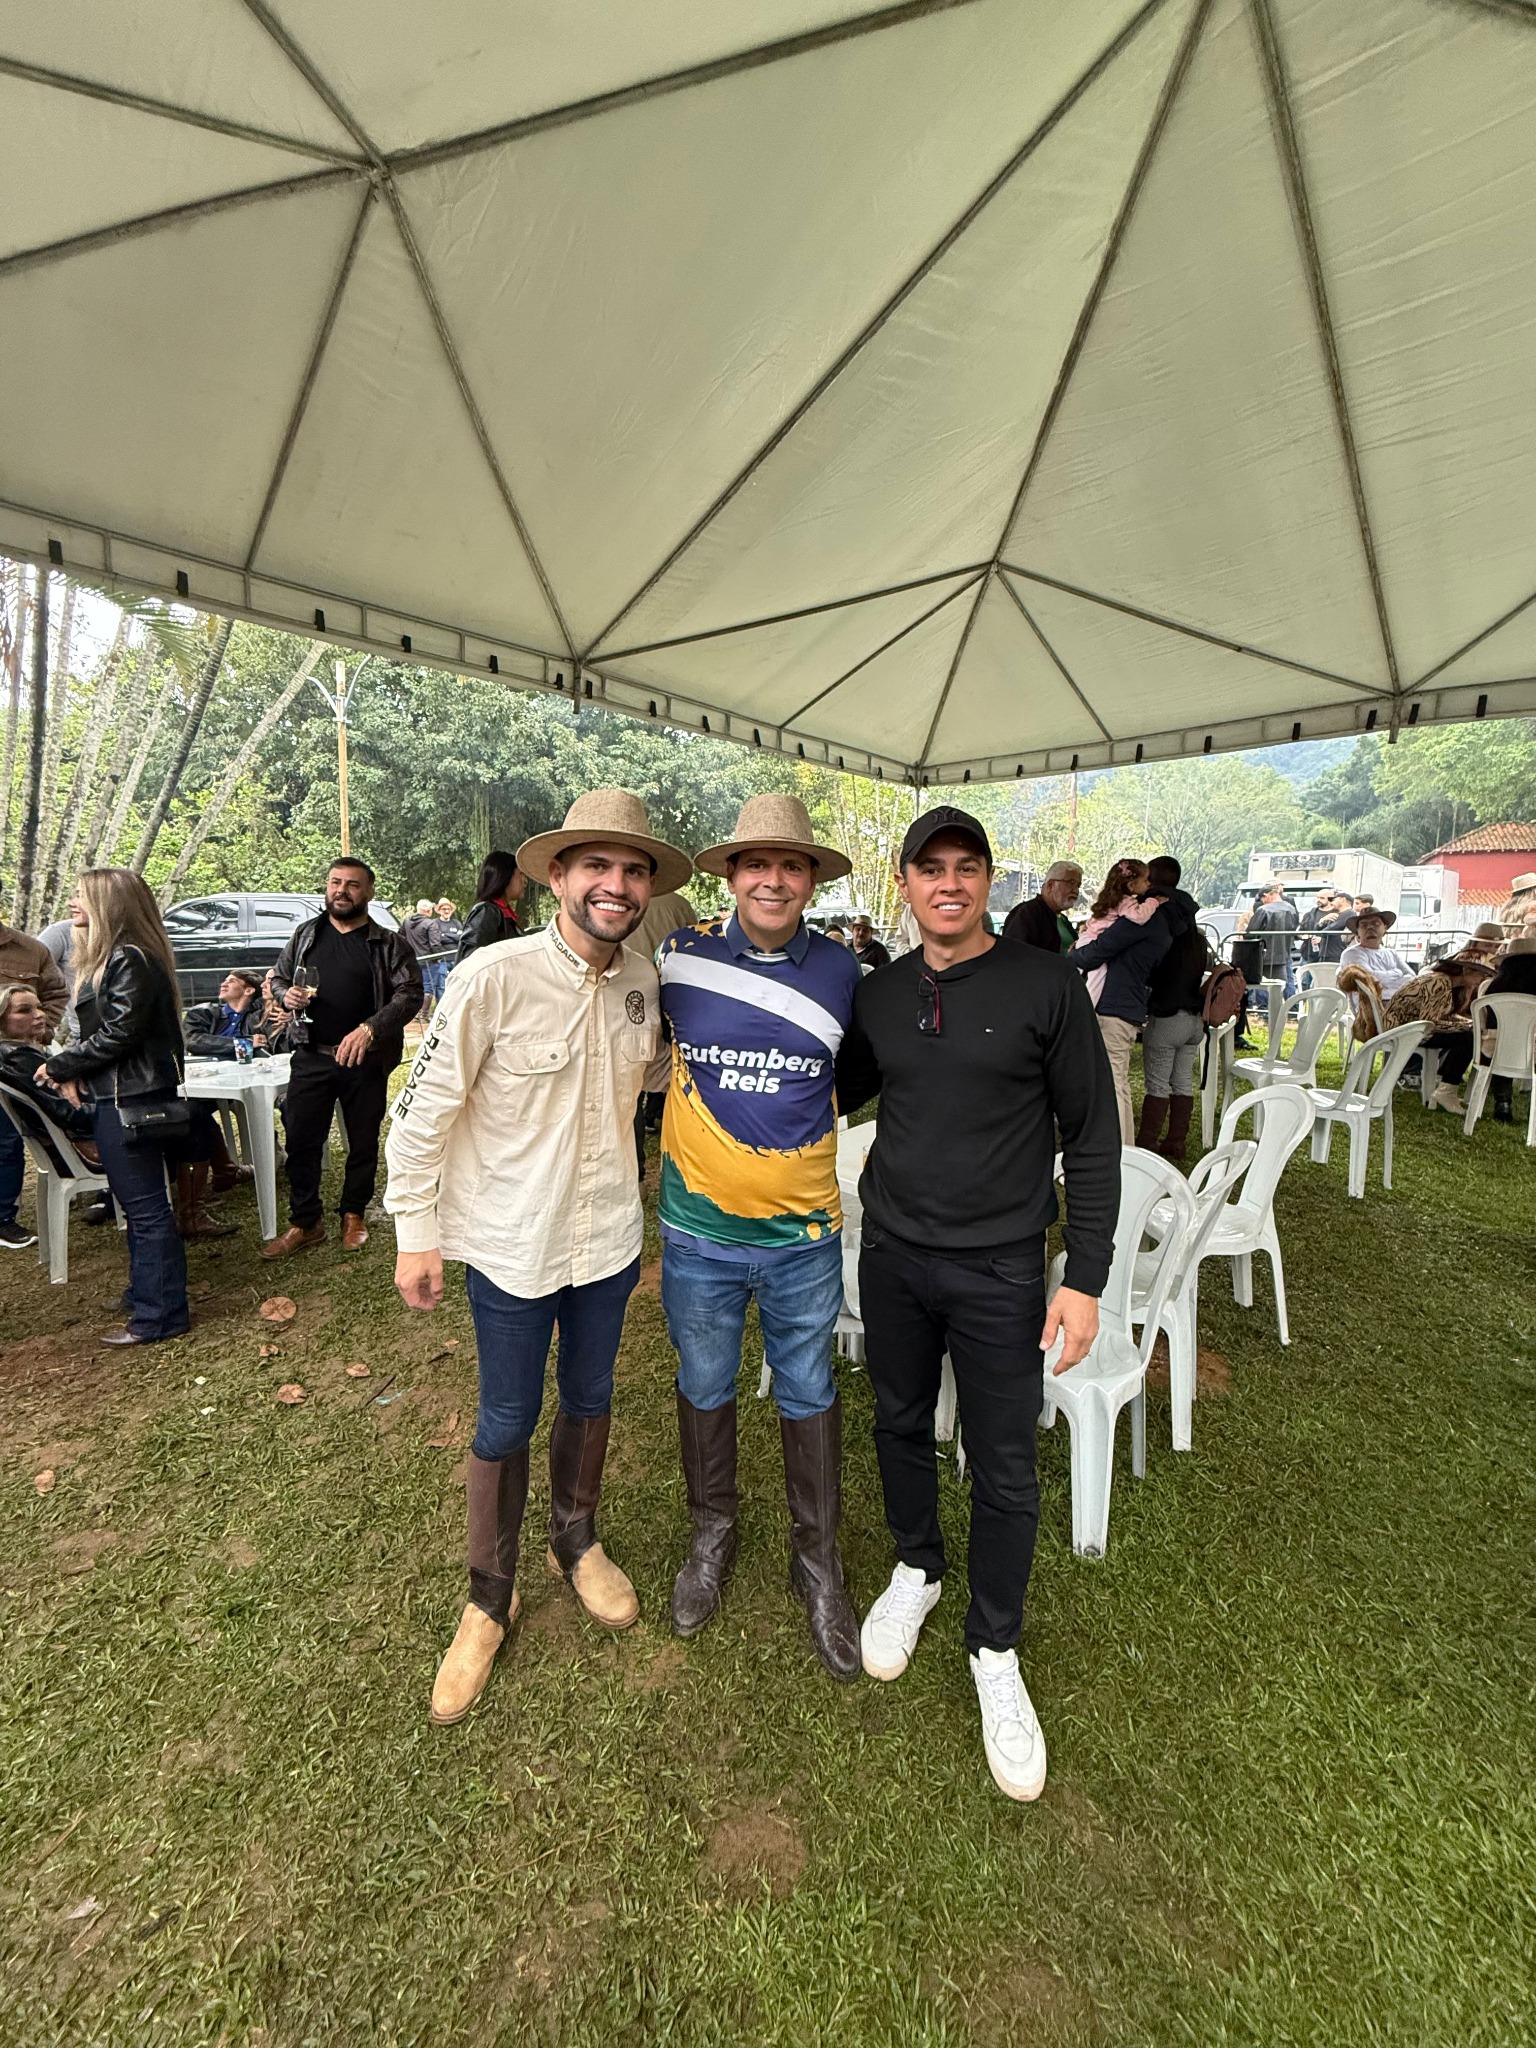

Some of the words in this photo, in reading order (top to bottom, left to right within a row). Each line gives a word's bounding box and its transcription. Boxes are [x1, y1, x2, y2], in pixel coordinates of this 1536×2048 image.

[395, 1032, 440, 1120] RADADE
[678, 1042, 825, 1077] Gutemberg
[718, 1069, 781, 1094] Reis
